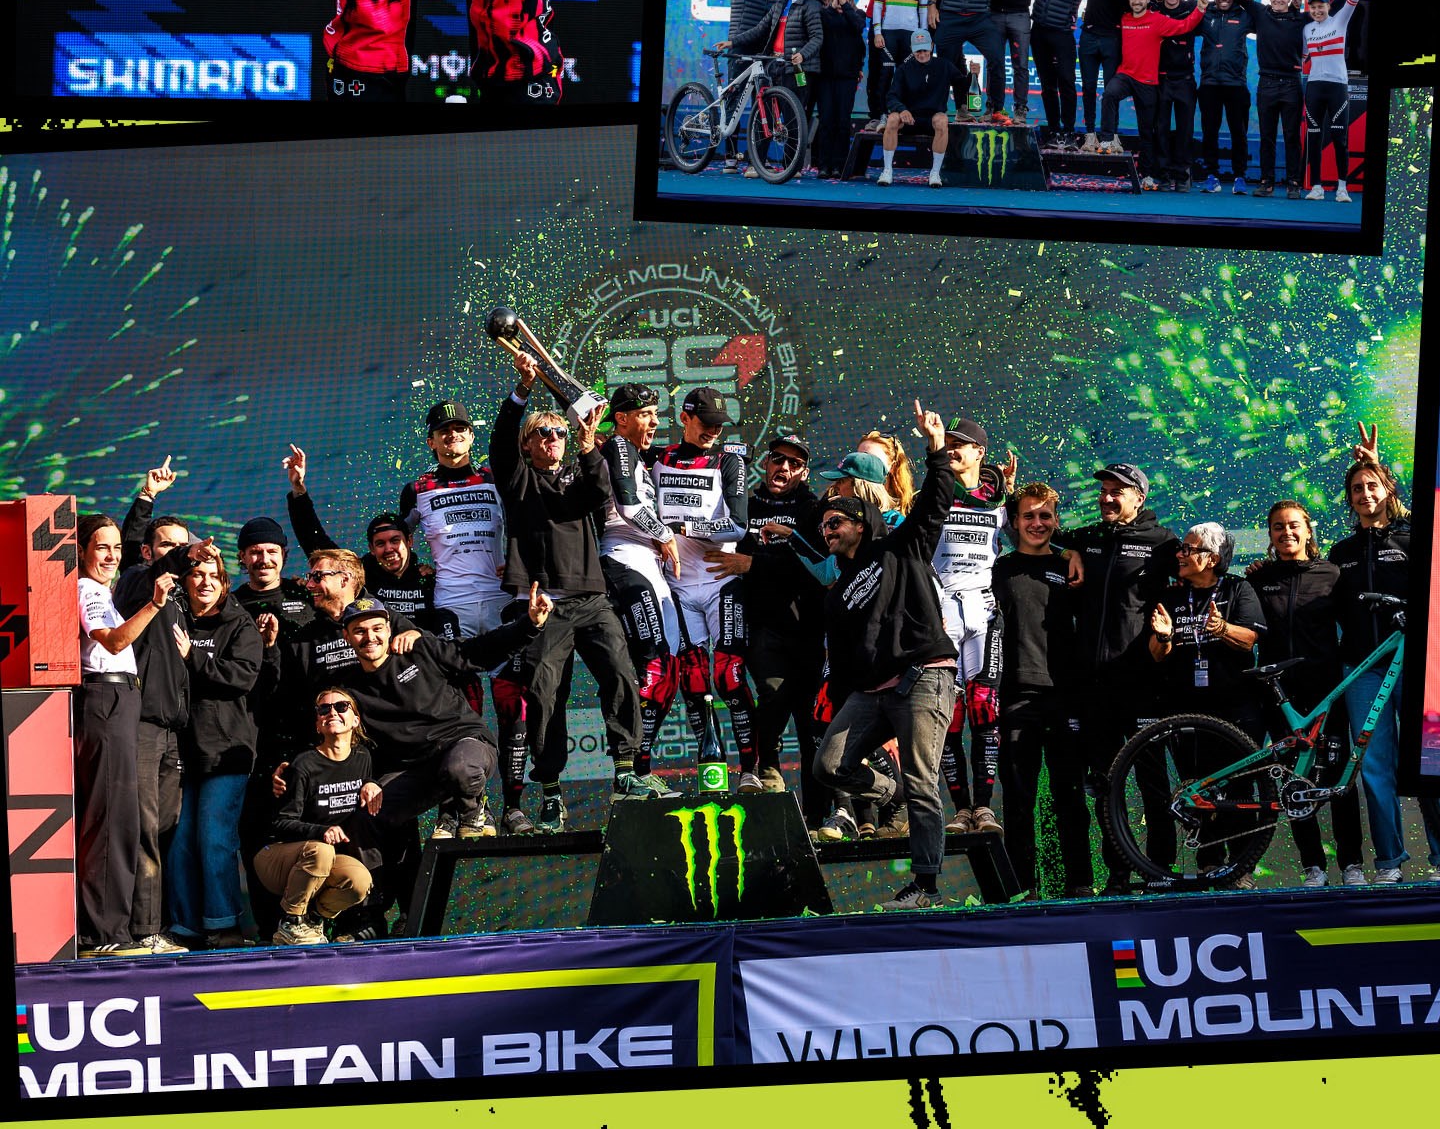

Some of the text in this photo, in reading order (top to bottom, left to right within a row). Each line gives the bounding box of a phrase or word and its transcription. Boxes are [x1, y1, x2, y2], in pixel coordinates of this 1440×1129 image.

[68, 58, 296, 92] SHIMANO
[628, 262, 784, 338] MOUNTAIN
[649, 307, 700, 329] UCI
[434, 492, 495, 507] COMMENCAL
[660, 475, 710, 488] COMMENCAL
[1139, 932, 1267, 987] UCI
[33, 996, 161, 1051] UCI
[19, 1024, 673, 1097] MOUNTAIN BIKE
